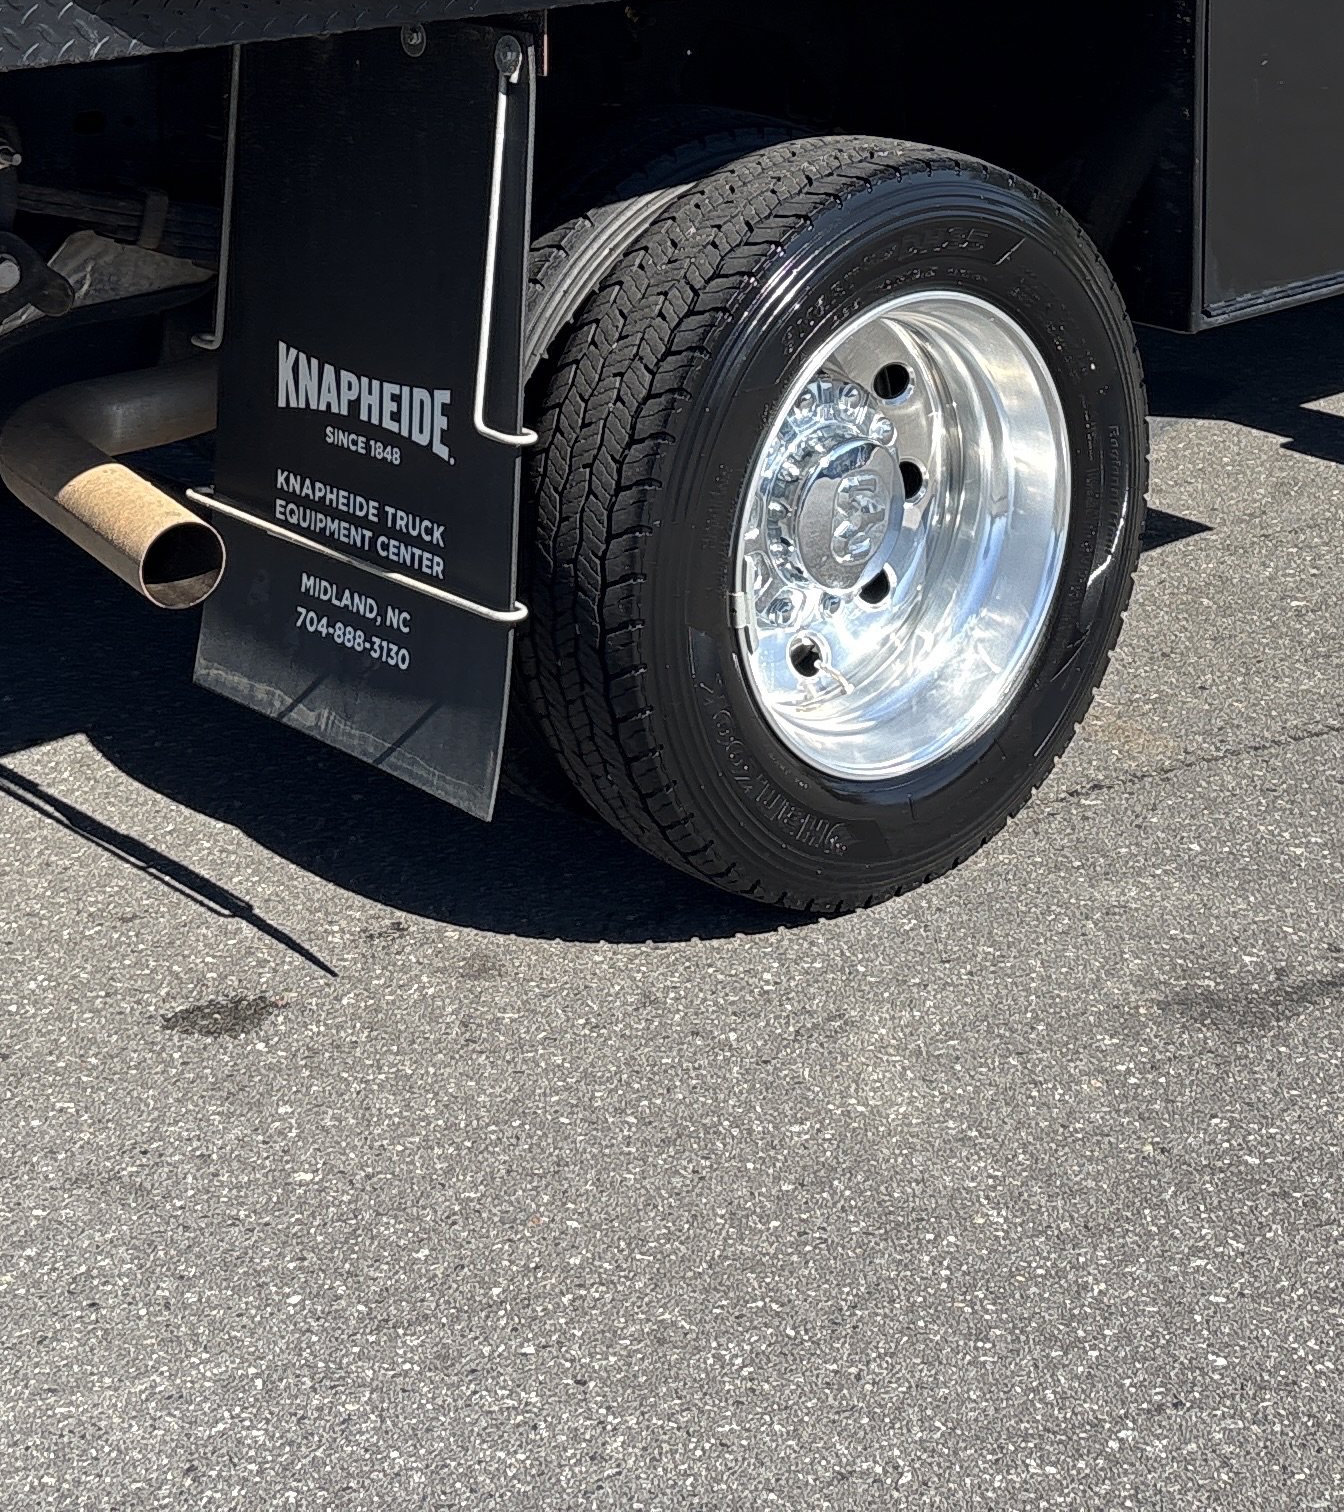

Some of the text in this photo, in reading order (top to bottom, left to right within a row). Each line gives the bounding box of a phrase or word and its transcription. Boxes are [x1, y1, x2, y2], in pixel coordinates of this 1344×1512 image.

[325, 425, 401, 465] SINCE 1848
[275, 498, 444, 580] EQUIPMENT CENTER
[276, 468, 445, 548] KNAPHEIDE TRUCK
[300, 572, 411, 634] MIDLAND, NC
[295, 606, 411, 670] 704-888-3130
